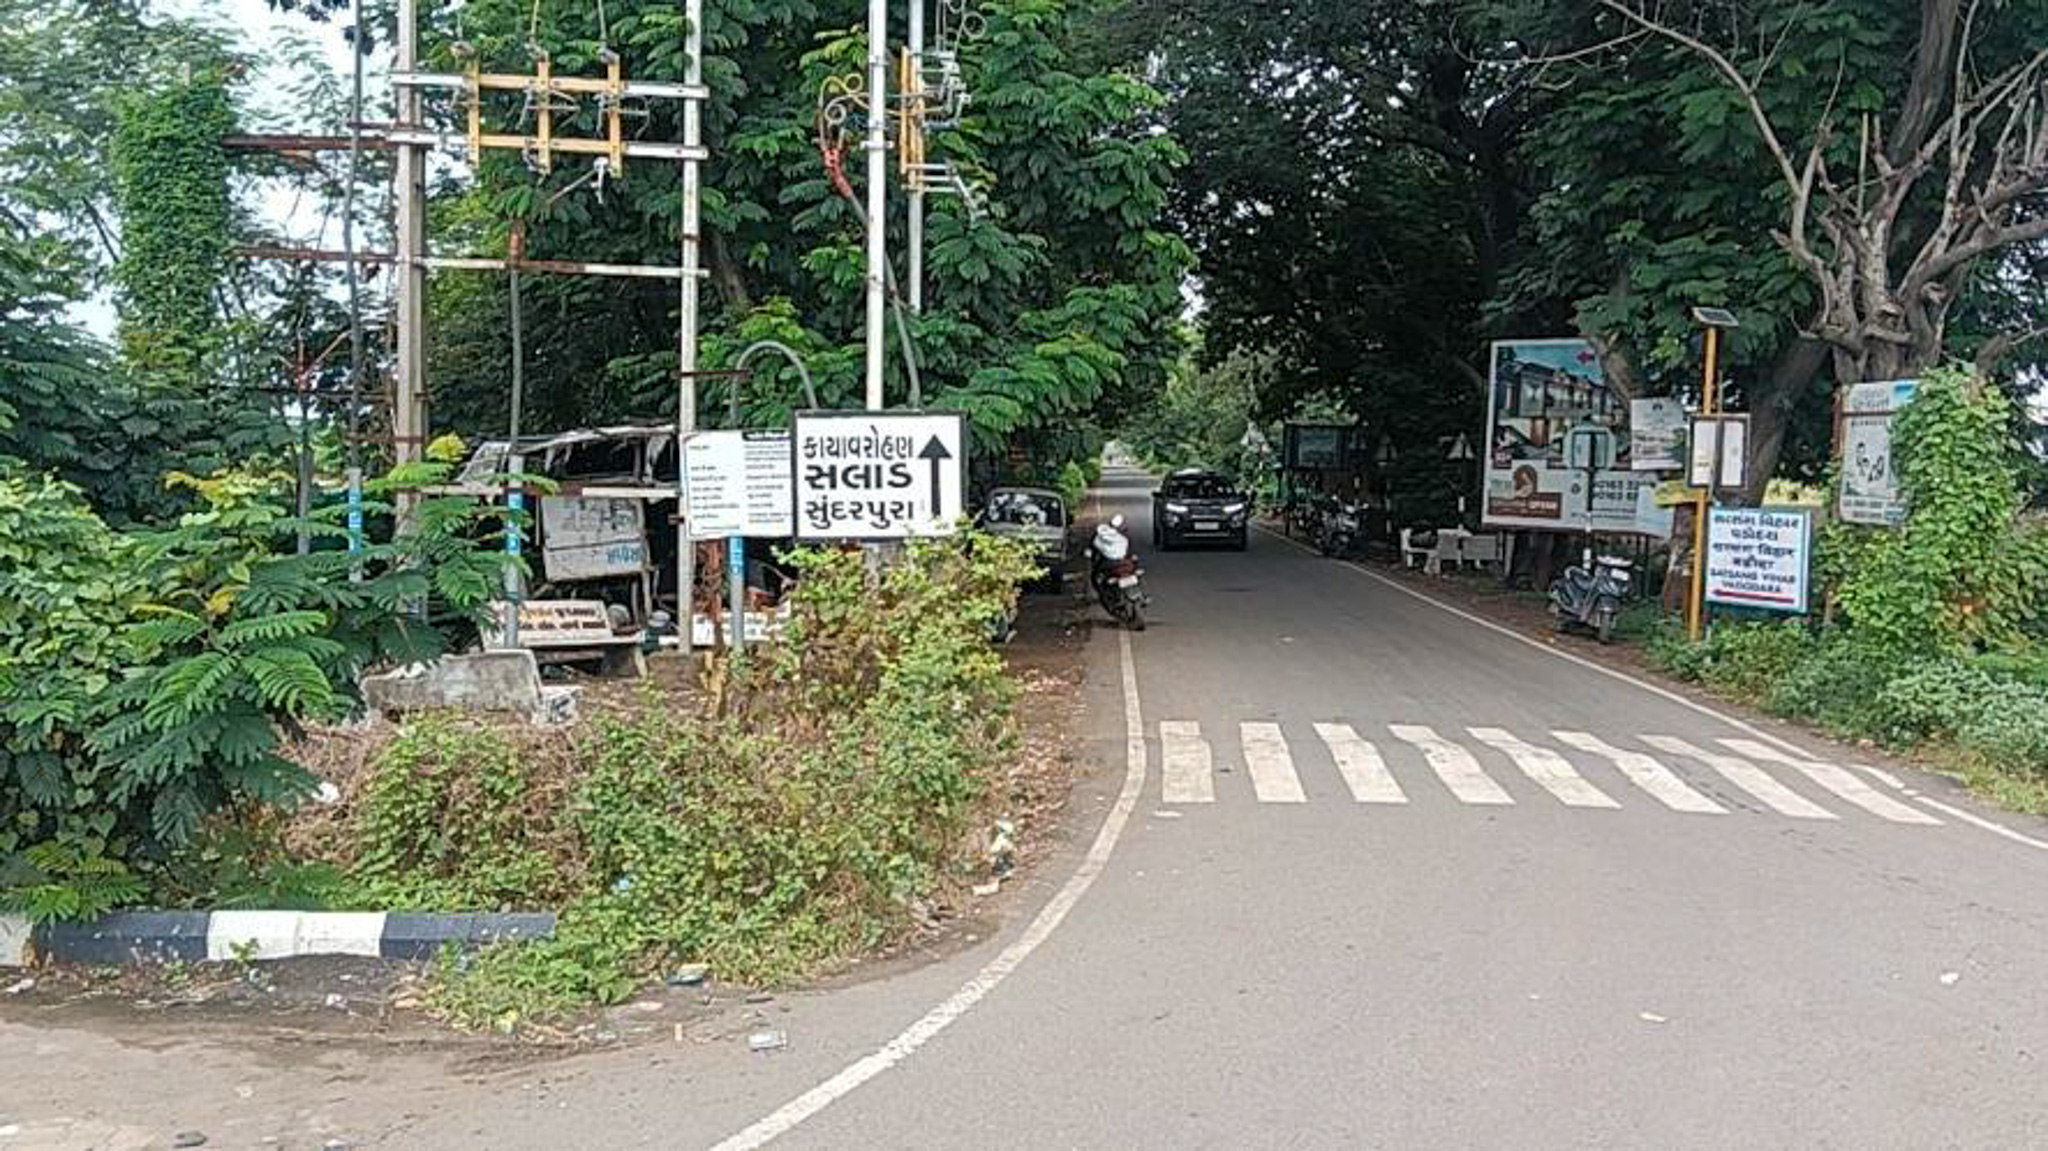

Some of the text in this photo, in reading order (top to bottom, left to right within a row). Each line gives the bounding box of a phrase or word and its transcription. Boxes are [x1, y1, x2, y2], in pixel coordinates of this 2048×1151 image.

[803, 424, 914, 461] કાયાવરોહણ
[804, 462, 914, 490] સલાડ
[804, 494, 914, 530] સુંદરપુરા
